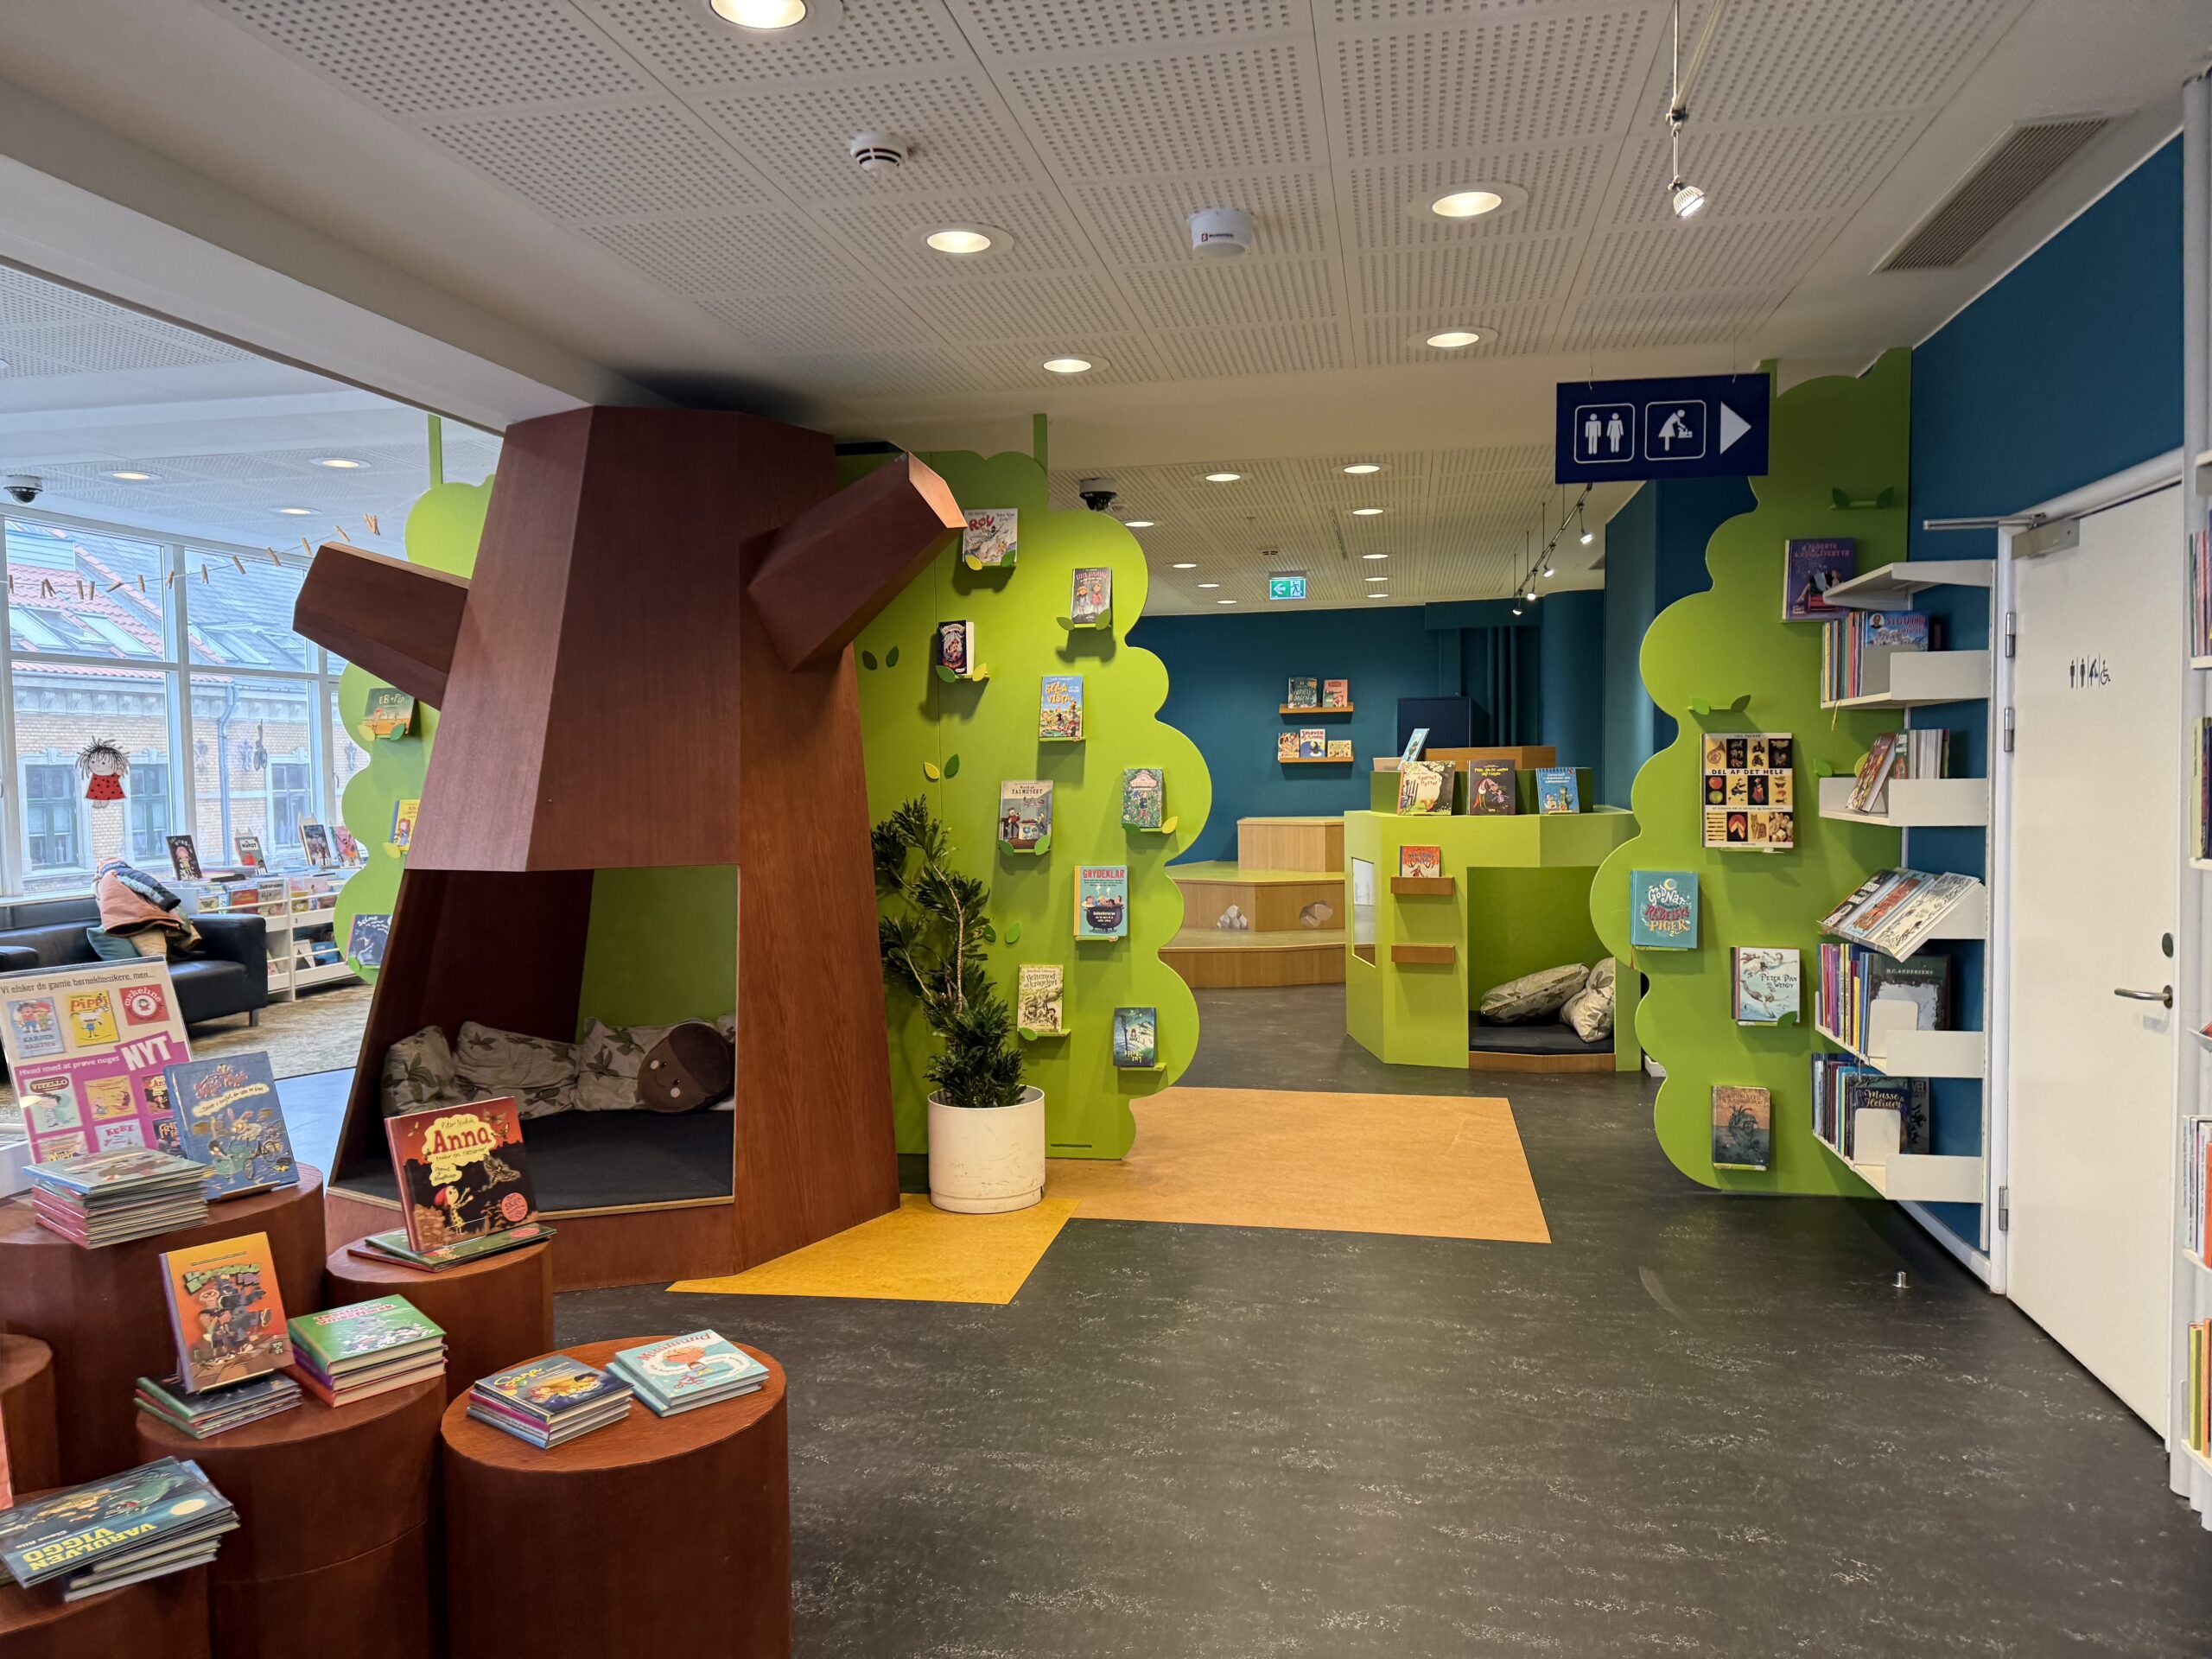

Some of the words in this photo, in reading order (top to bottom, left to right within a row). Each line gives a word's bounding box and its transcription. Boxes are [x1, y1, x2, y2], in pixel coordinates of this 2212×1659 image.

[1083, 869, 1125, 879] GRYDEKLAR
[1646, 919, 1690, 932] PIGER
[1760, 973, 1781, 982] PETER
[120, 1035, 172, 1071] NYT
[19, 1066, 41, 1076] Hvad
[42, 1064, 61, 1073] med
[432, 1126, 493, 1154] Anna
[22, 1527, 118, 1563] VIGGO
[29, 1522, 157, 1571] VARULVEN
